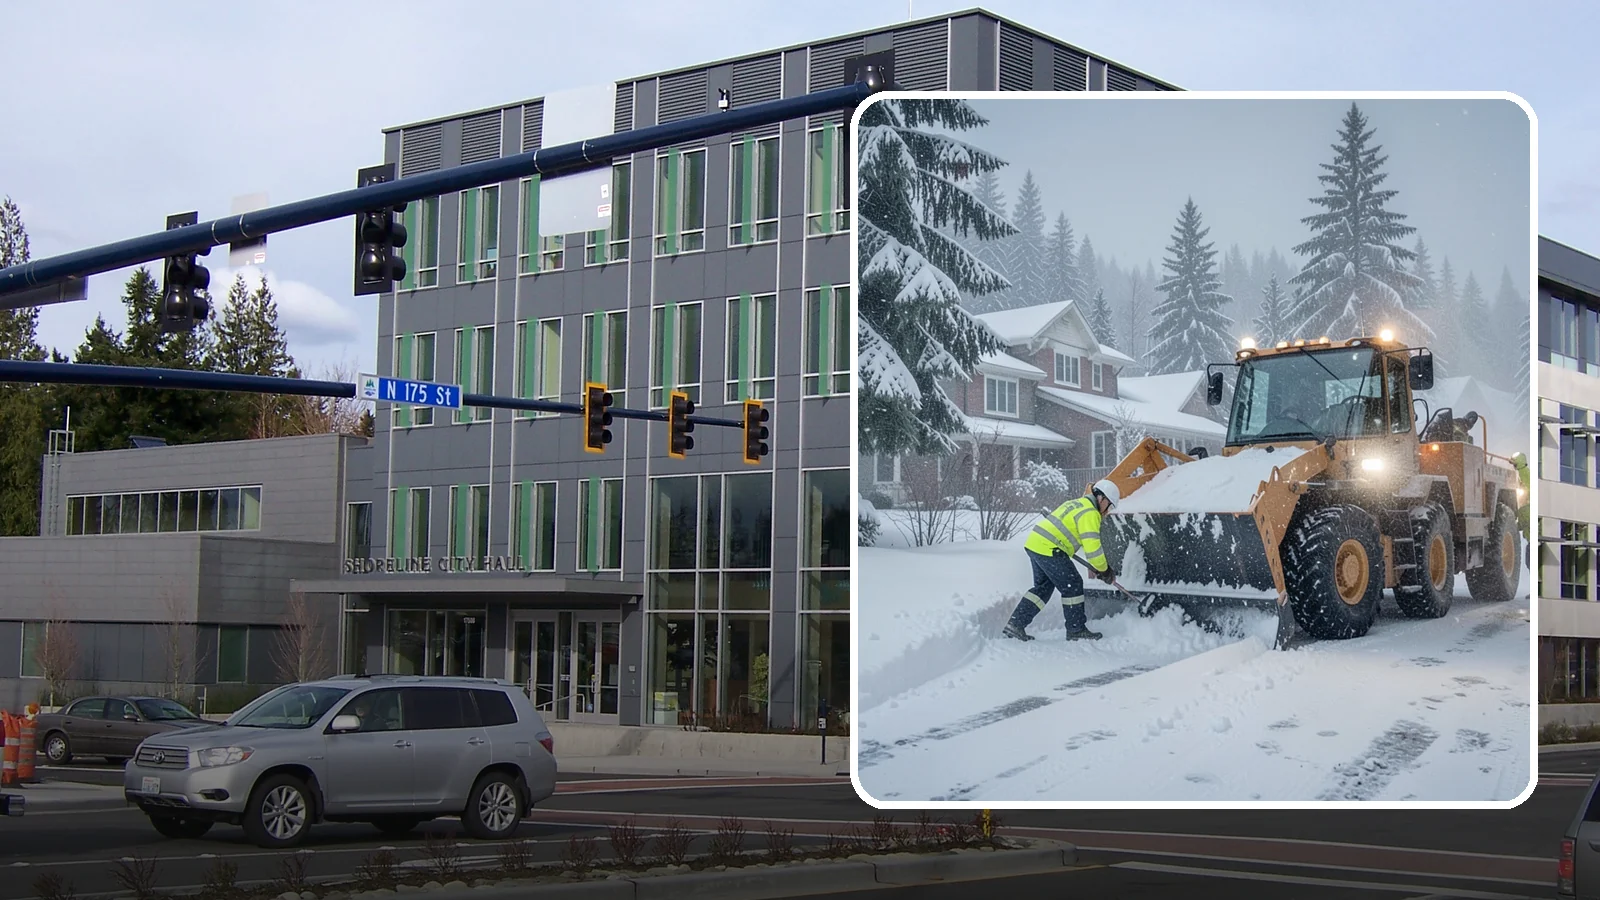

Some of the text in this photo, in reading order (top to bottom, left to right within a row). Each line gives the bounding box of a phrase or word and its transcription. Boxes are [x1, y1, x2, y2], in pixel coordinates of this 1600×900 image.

[387, 380, 451, 406] N 175 St
[344, 556, 526, 574] SHORELINE CITY HALL
